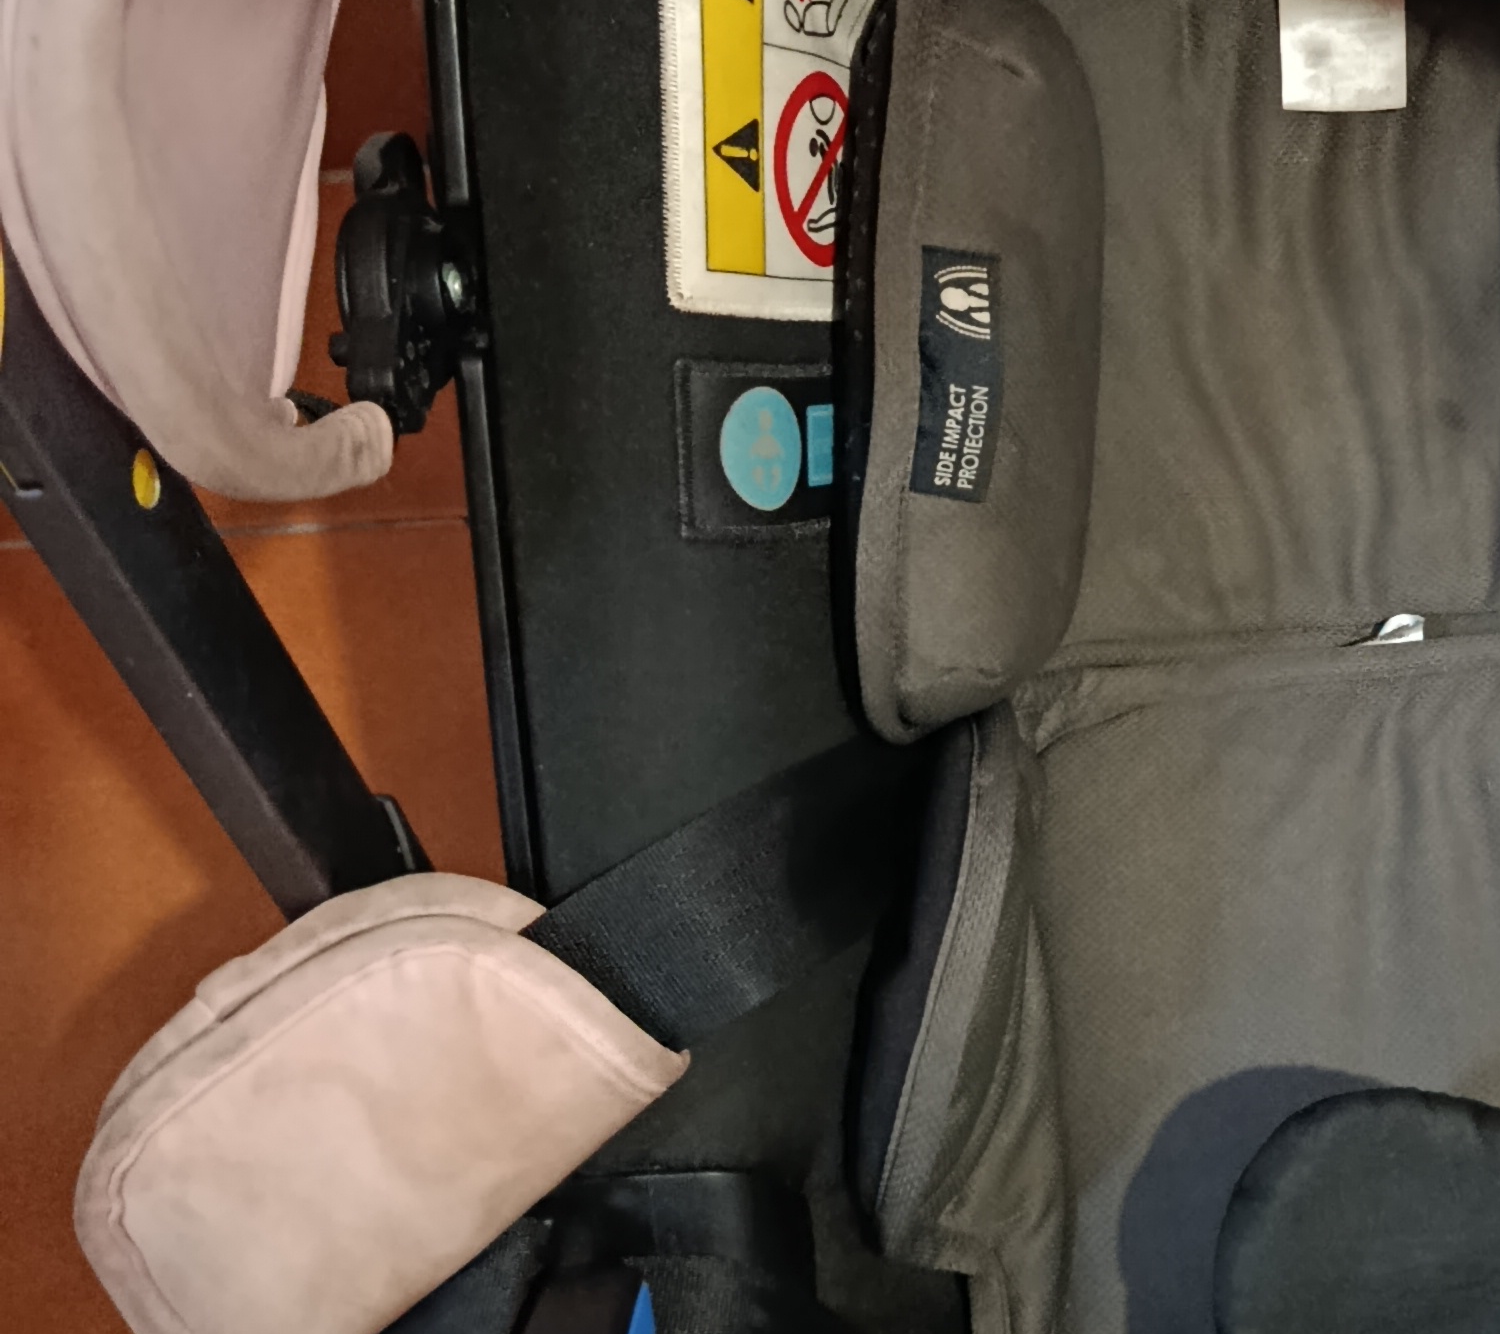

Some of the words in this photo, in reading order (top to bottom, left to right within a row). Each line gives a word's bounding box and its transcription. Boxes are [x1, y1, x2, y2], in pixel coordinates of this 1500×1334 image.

[941, 383, 967, 449] IMPACT
[956, 385, 989, 490] PROTECTION
[933, 451, 957, 486] SIDE
